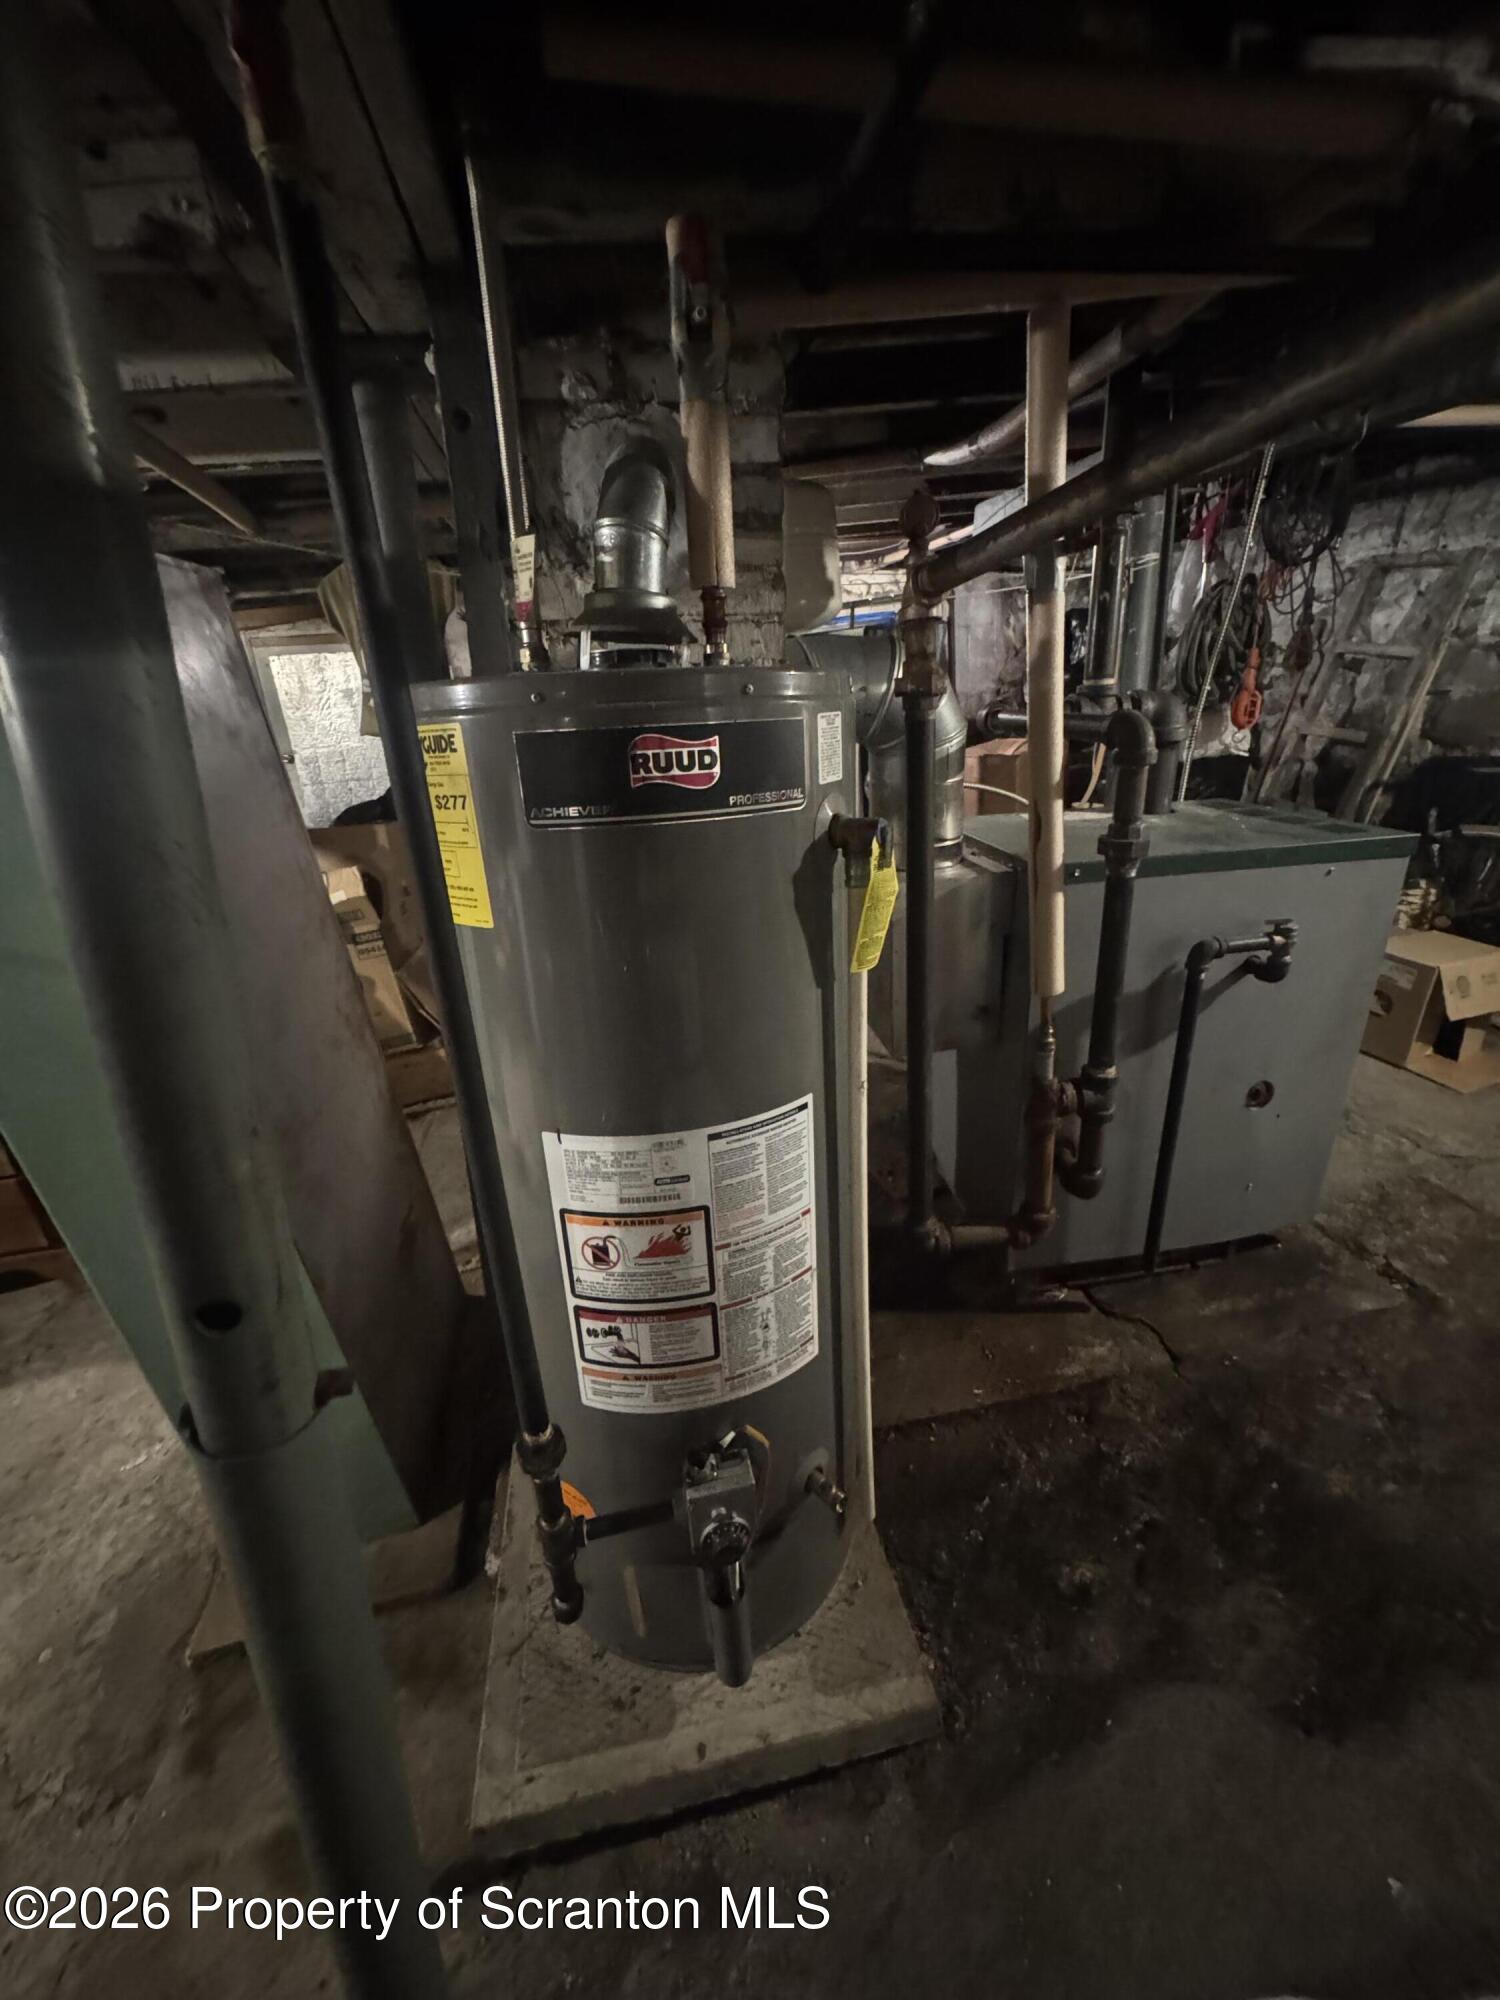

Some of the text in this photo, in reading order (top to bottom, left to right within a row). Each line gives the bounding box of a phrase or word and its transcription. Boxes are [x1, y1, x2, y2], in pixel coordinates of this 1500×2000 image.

[631, 749, 718, 775] RUUD
[434, 795, 467, 810] $277
[729, 788, 804, 806] PROFESSIONAL
[614, 1218, 665, 1227] WARNING
